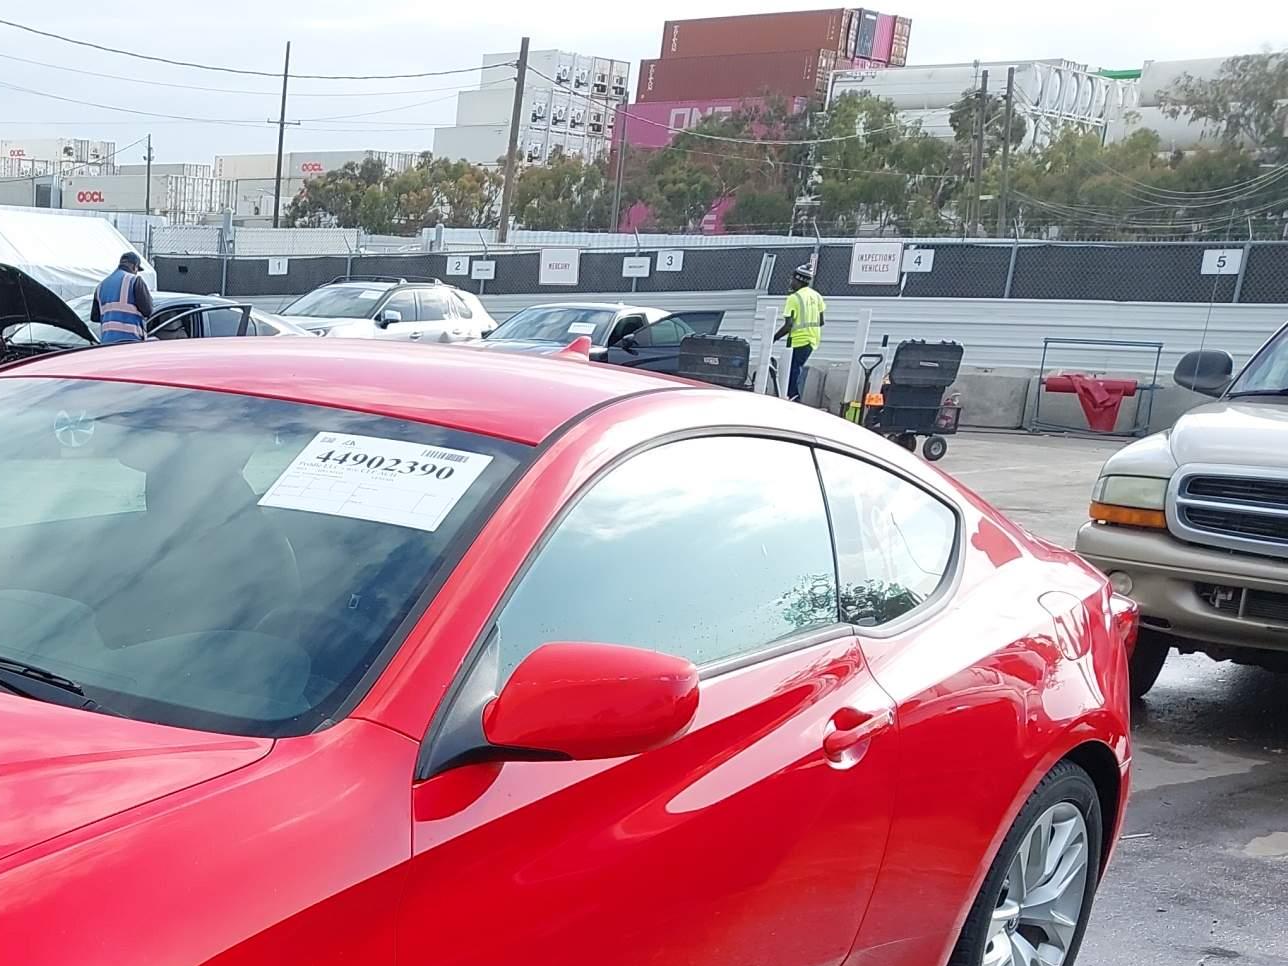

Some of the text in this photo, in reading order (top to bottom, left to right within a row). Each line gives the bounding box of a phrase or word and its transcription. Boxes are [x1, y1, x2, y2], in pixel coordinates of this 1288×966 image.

[77, 191, 104, 203] OOCL
[666, 255, 674, 266] 3
[857, 253, 896, 262] INSPECTIONS
[913, 255, 922, 267] 4
[1216, 255, 1227, 268] 5
[454, 261, 461, 271] 2
[861, 264, 889, 272] VEHICLES
[316, 450, 455, 480] 44902390
